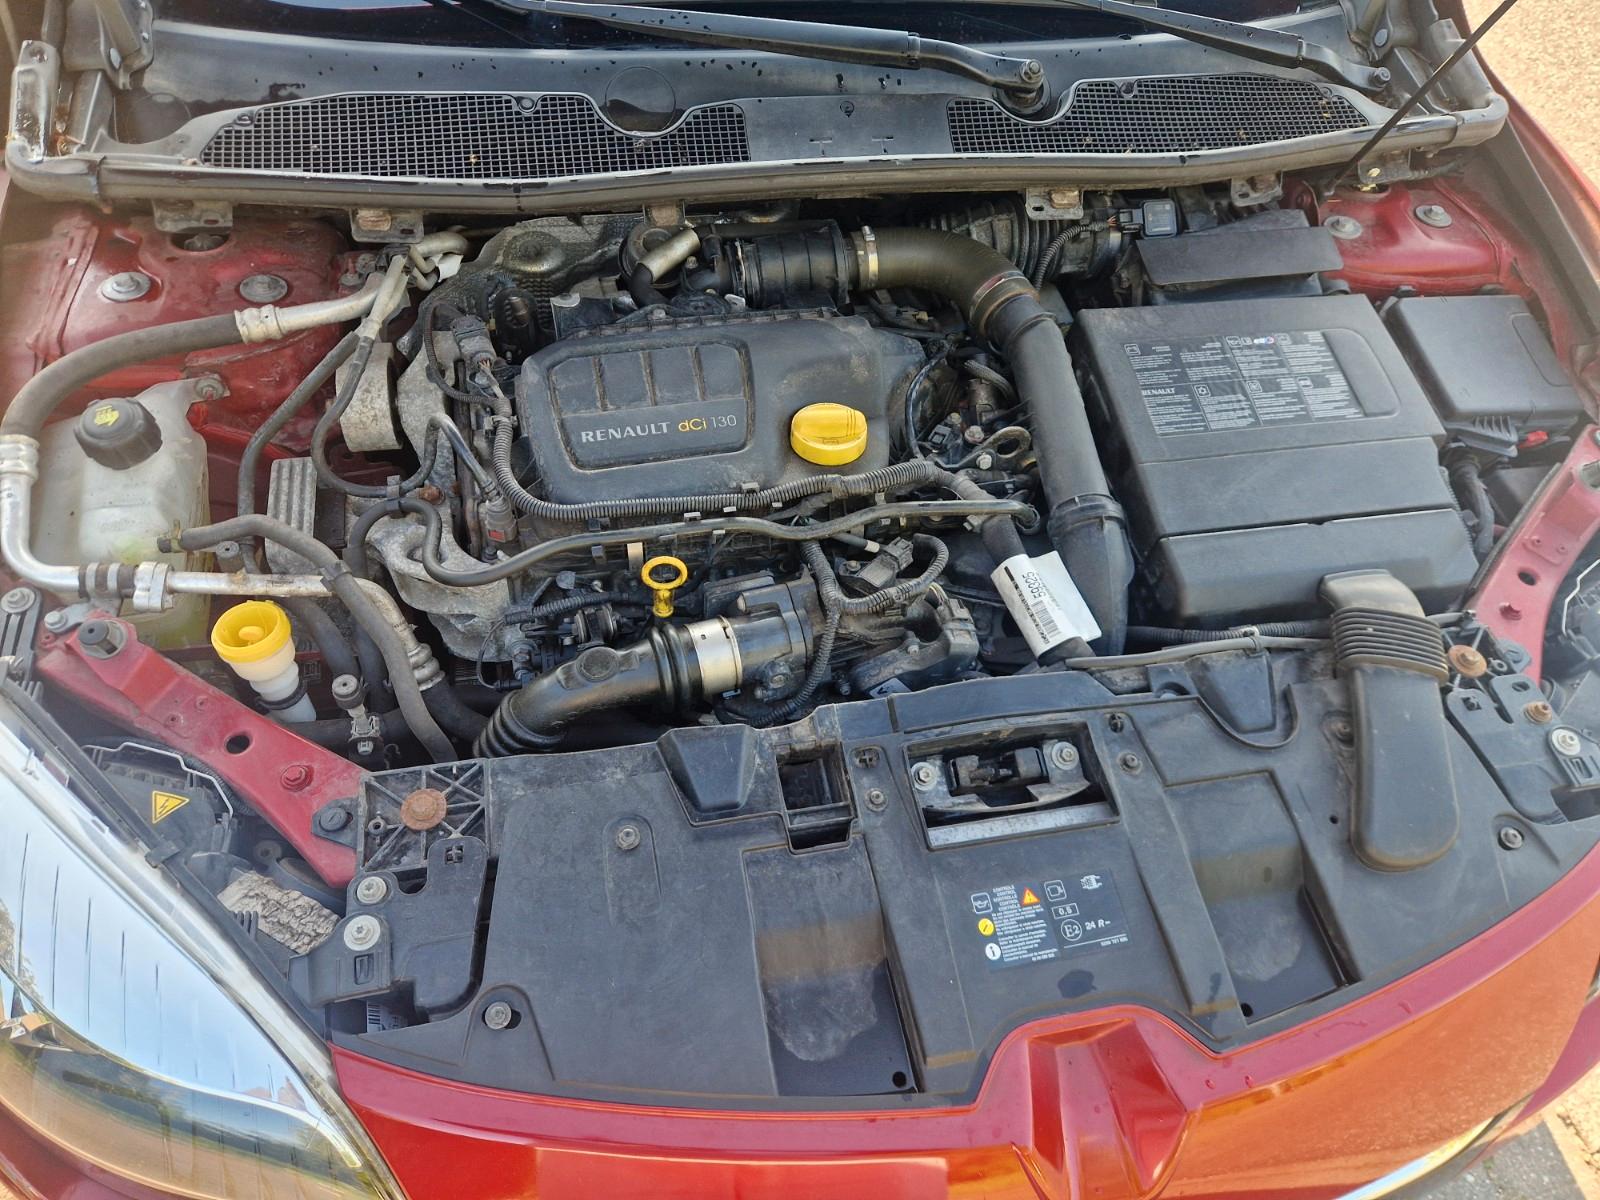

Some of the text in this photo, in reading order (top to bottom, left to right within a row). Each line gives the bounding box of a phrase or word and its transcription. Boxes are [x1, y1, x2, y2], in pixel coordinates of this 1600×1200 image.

[1141, 387, 1175, 396] RENAULT
[581, 414, 737, 443] RENAULT dCi 130
[1085, 920, 1097, 930] 24
